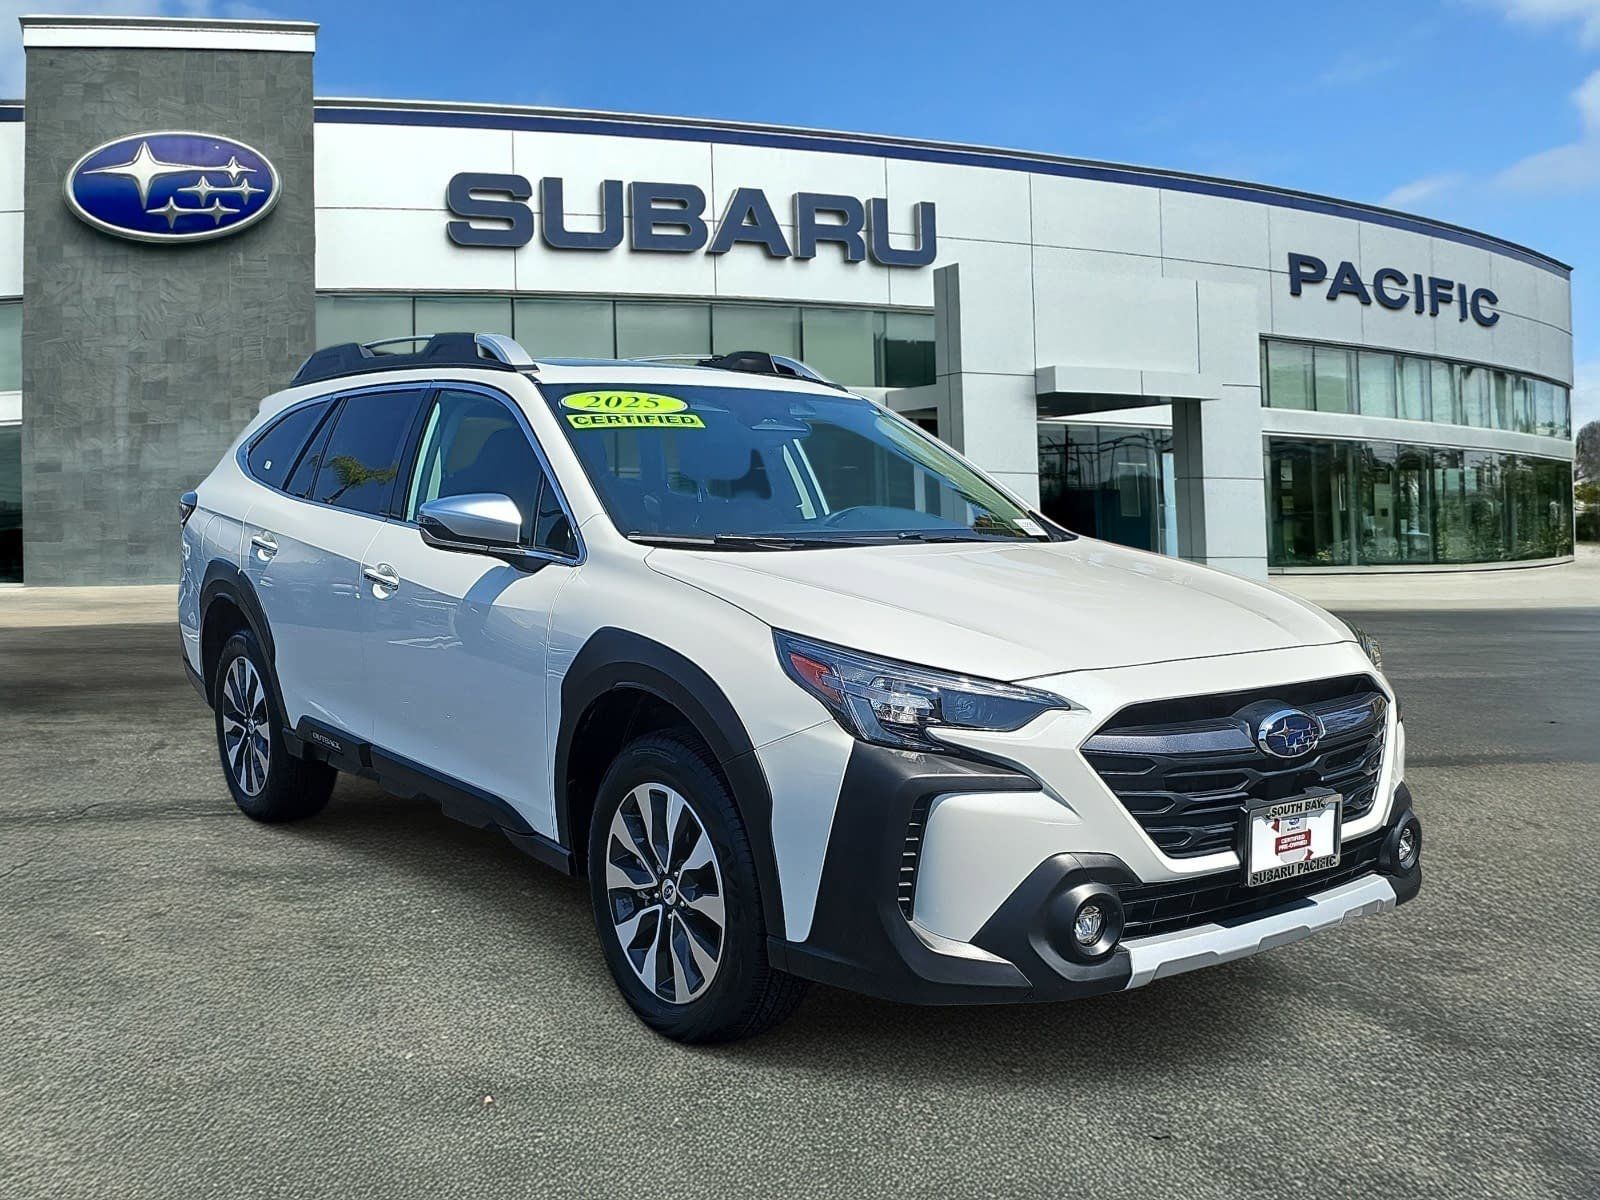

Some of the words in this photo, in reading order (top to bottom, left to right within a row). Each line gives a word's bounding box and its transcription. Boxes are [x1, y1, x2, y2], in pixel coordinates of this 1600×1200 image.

[446, 172, 937, 268] SUBARU
[1288, 252, 1500, 327] PACIFIC
[585, 396, 661, 409] 2025
[573, 415, 696, 426] CERTIFIED
[1271, 802, 1302, 818] SOUTH
[1304, 799, 1323, 810] BAY
[1252, 867, 1295, 885] SUBARU
[1297, 856, 1337, 874] PACIFIC
